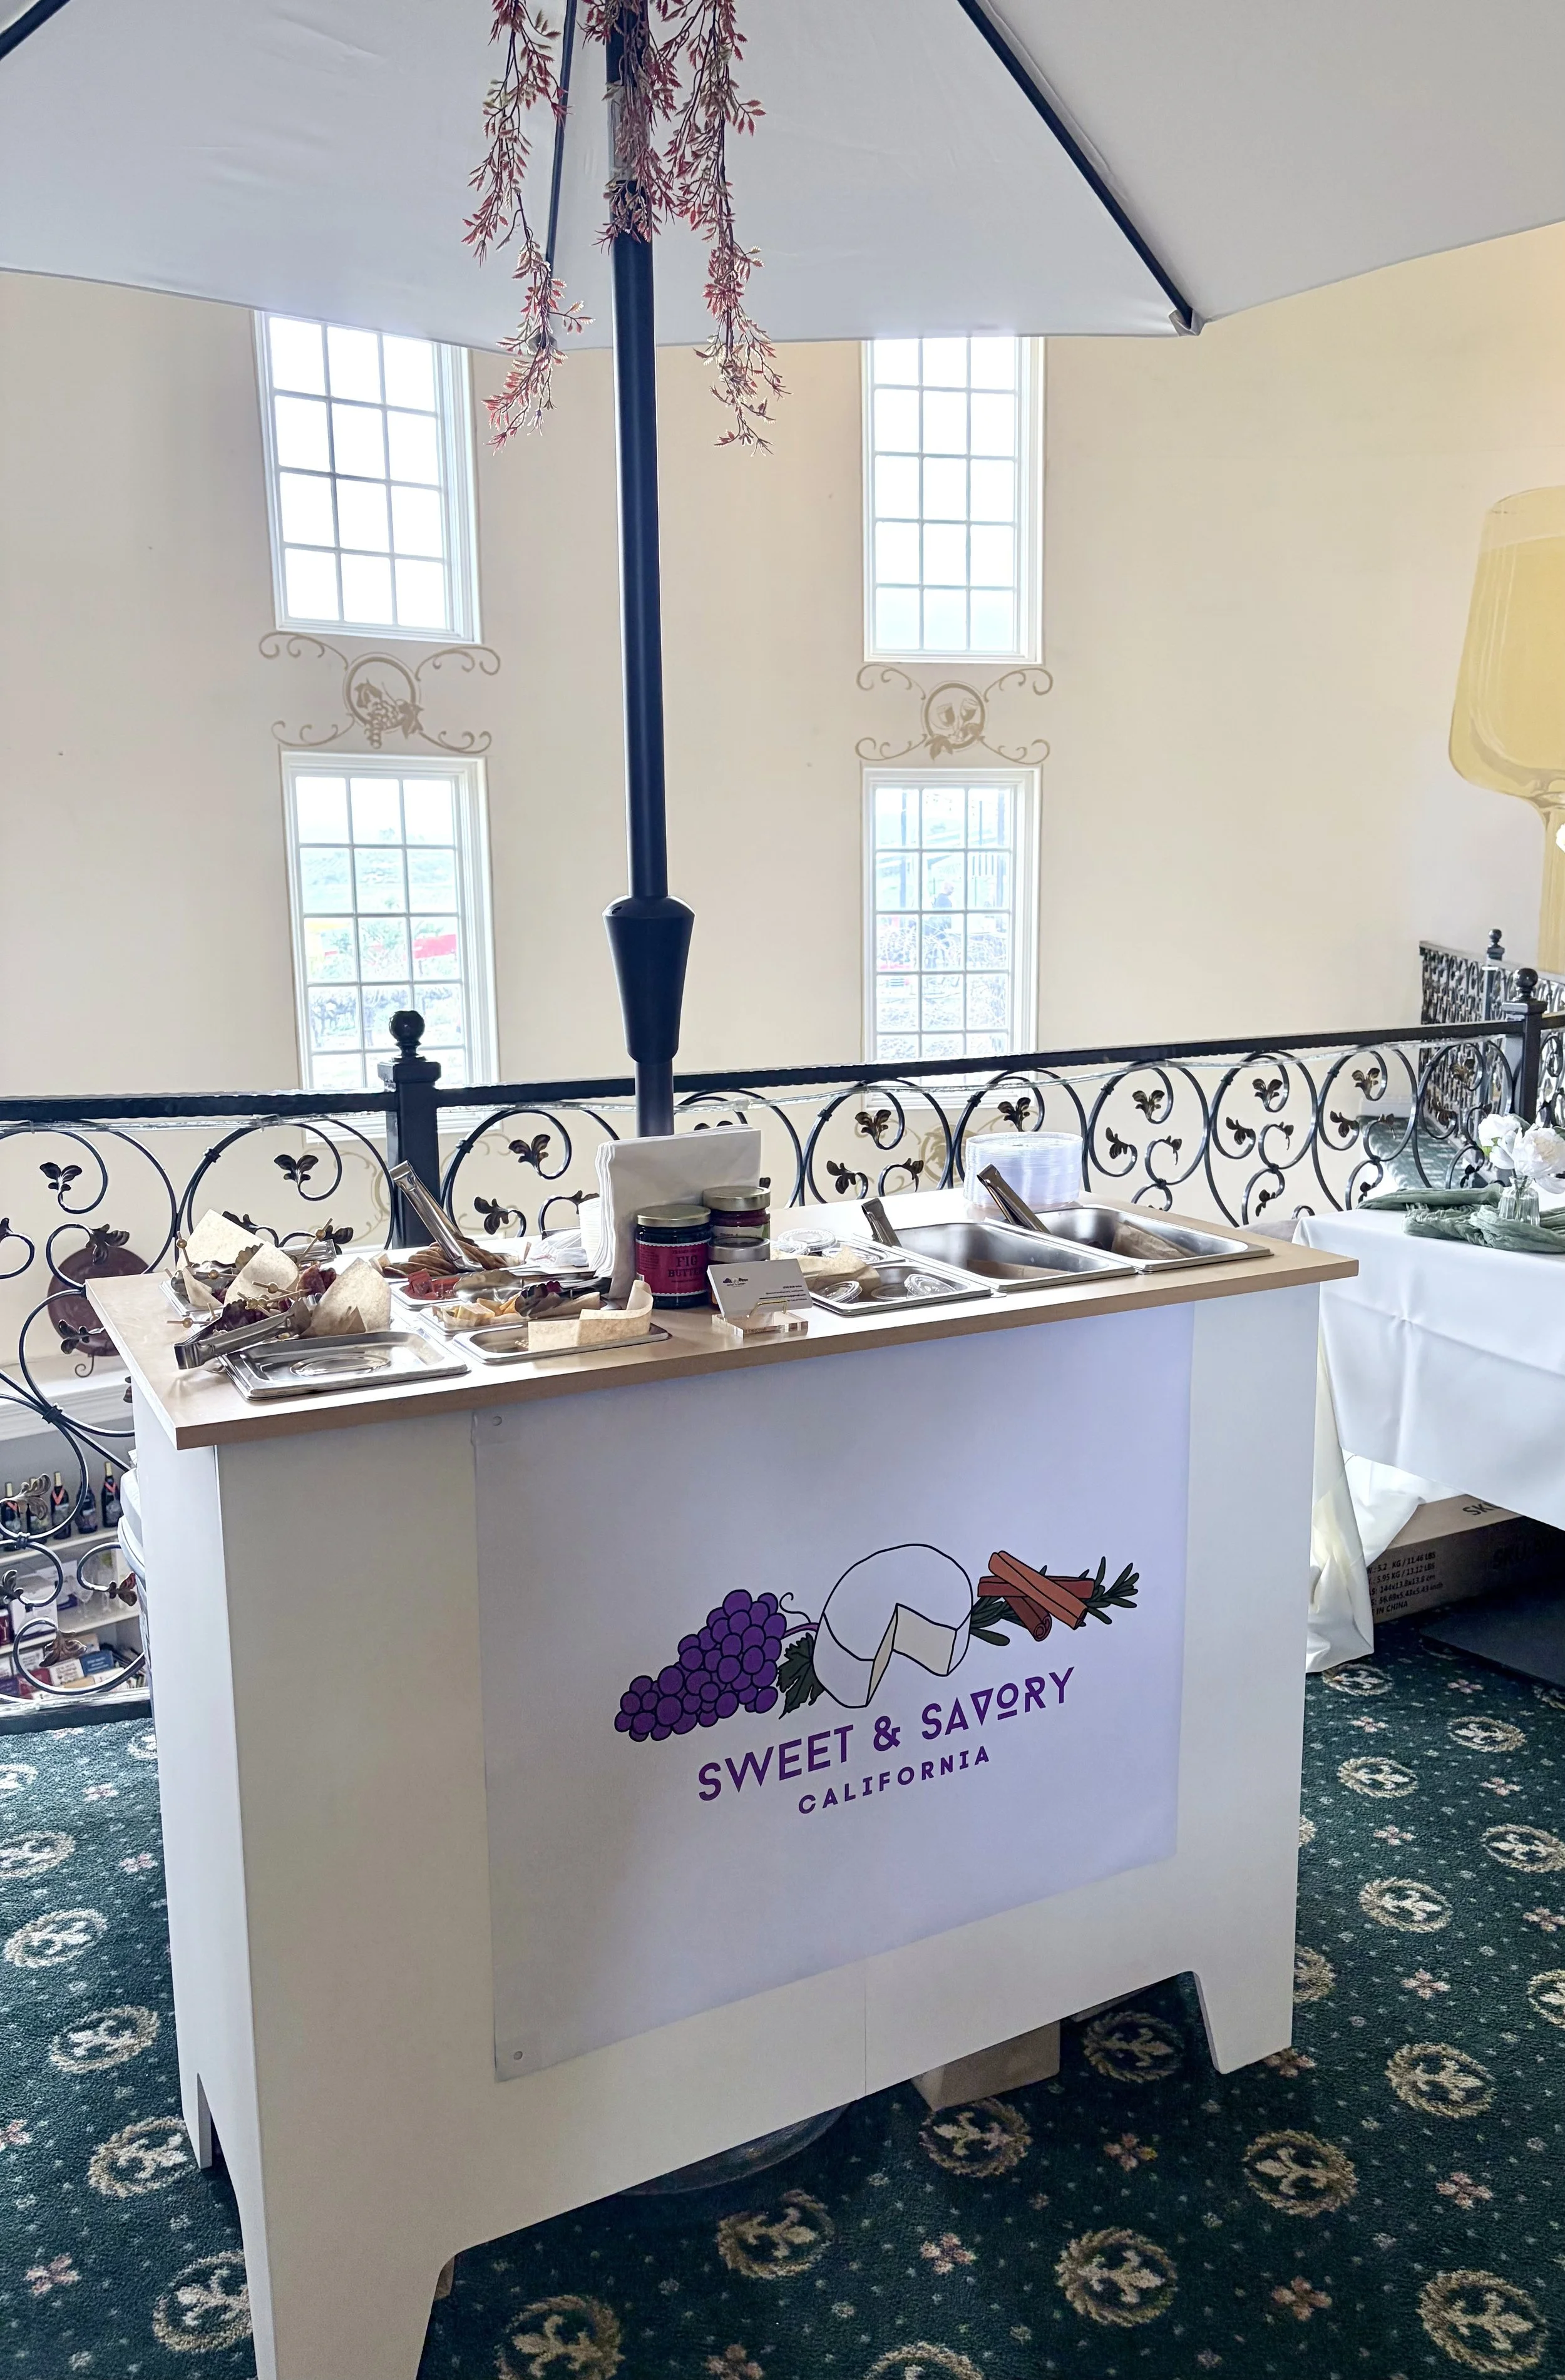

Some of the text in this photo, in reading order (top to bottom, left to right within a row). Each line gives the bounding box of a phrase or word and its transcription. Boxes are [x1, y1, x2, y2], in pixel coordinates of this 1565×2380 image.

[676, 1254, 698, 1267] FIG
[1392, 1560, 1401, 1569] KG
[1425, 1551, 1436, 1559] LBS
[1377, 1573, 1390, 1583] 5.95
[1392, 1571, 1400, 1579] KG
[1377, 1607, 1384, 1615] IN
[1386, 1600, 1408, 1612] CHINA
[697, 1666, 1075, 1802] SWEET & SAVORY
[798, 1745, 990, 1815] CALIFORNIA
